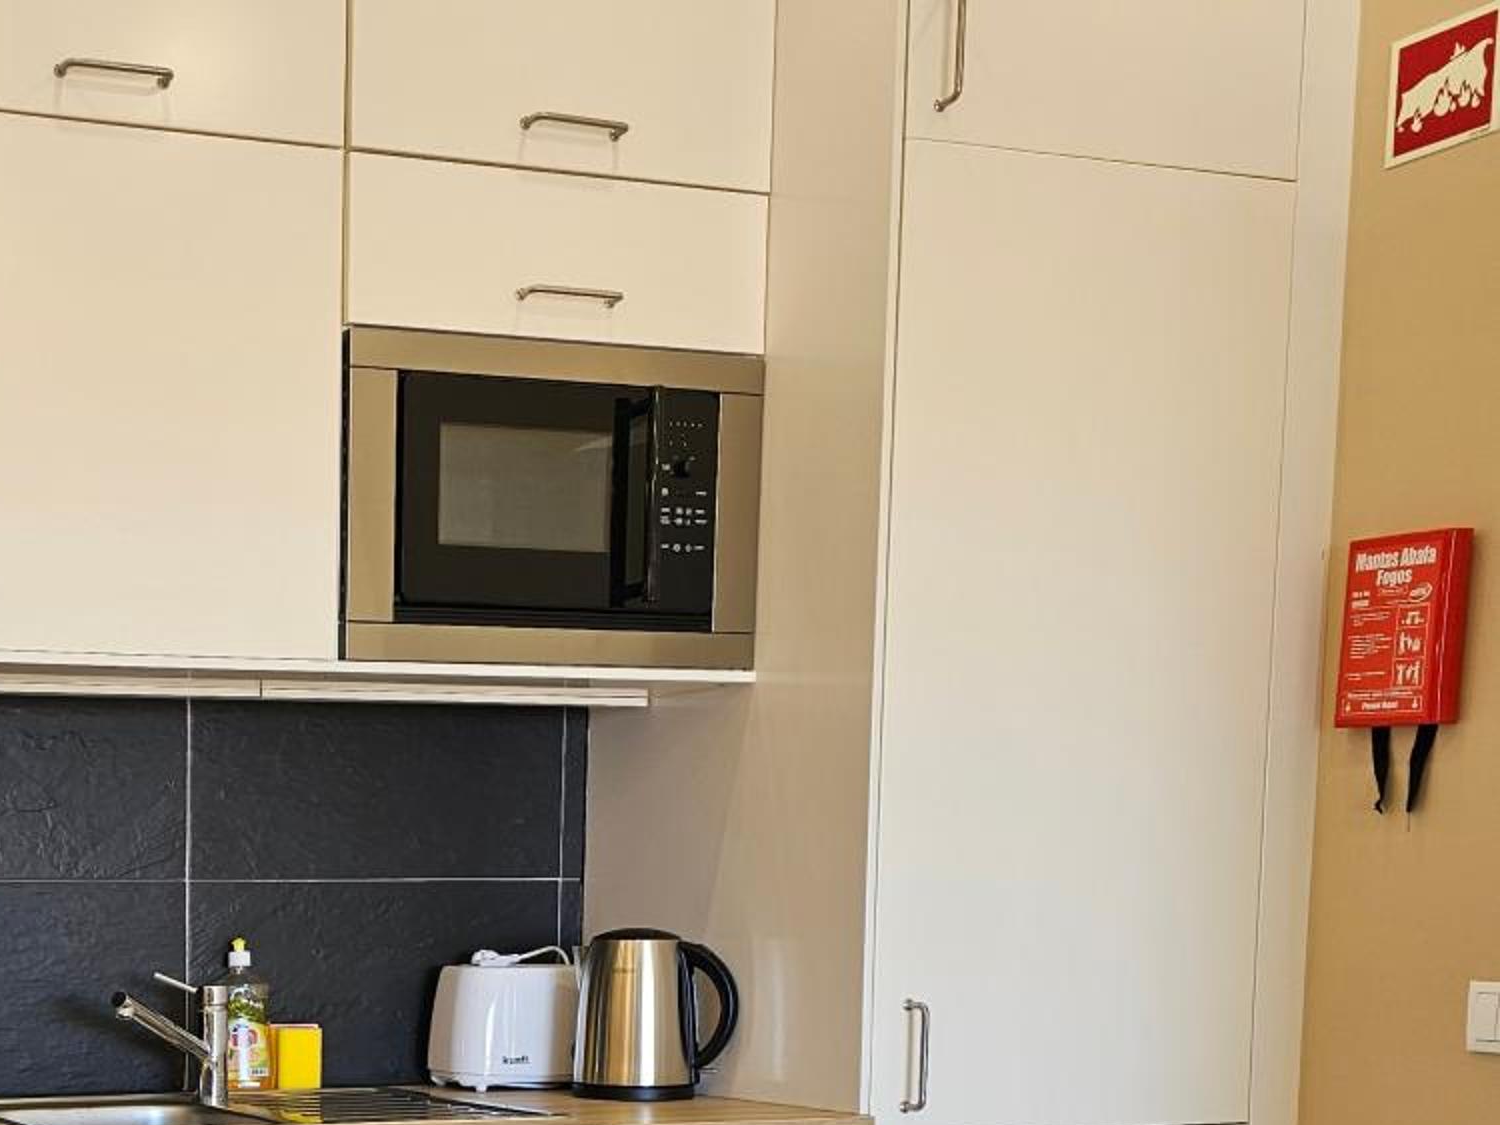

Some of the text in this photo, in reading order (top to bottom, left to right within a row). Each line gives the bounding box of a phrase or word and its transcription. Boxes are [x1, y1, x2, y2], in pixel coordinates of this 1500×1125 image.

[1355, 545, 1437, 574] Mantas Abafa
[1375, 568, 1412, 588] Fogos
